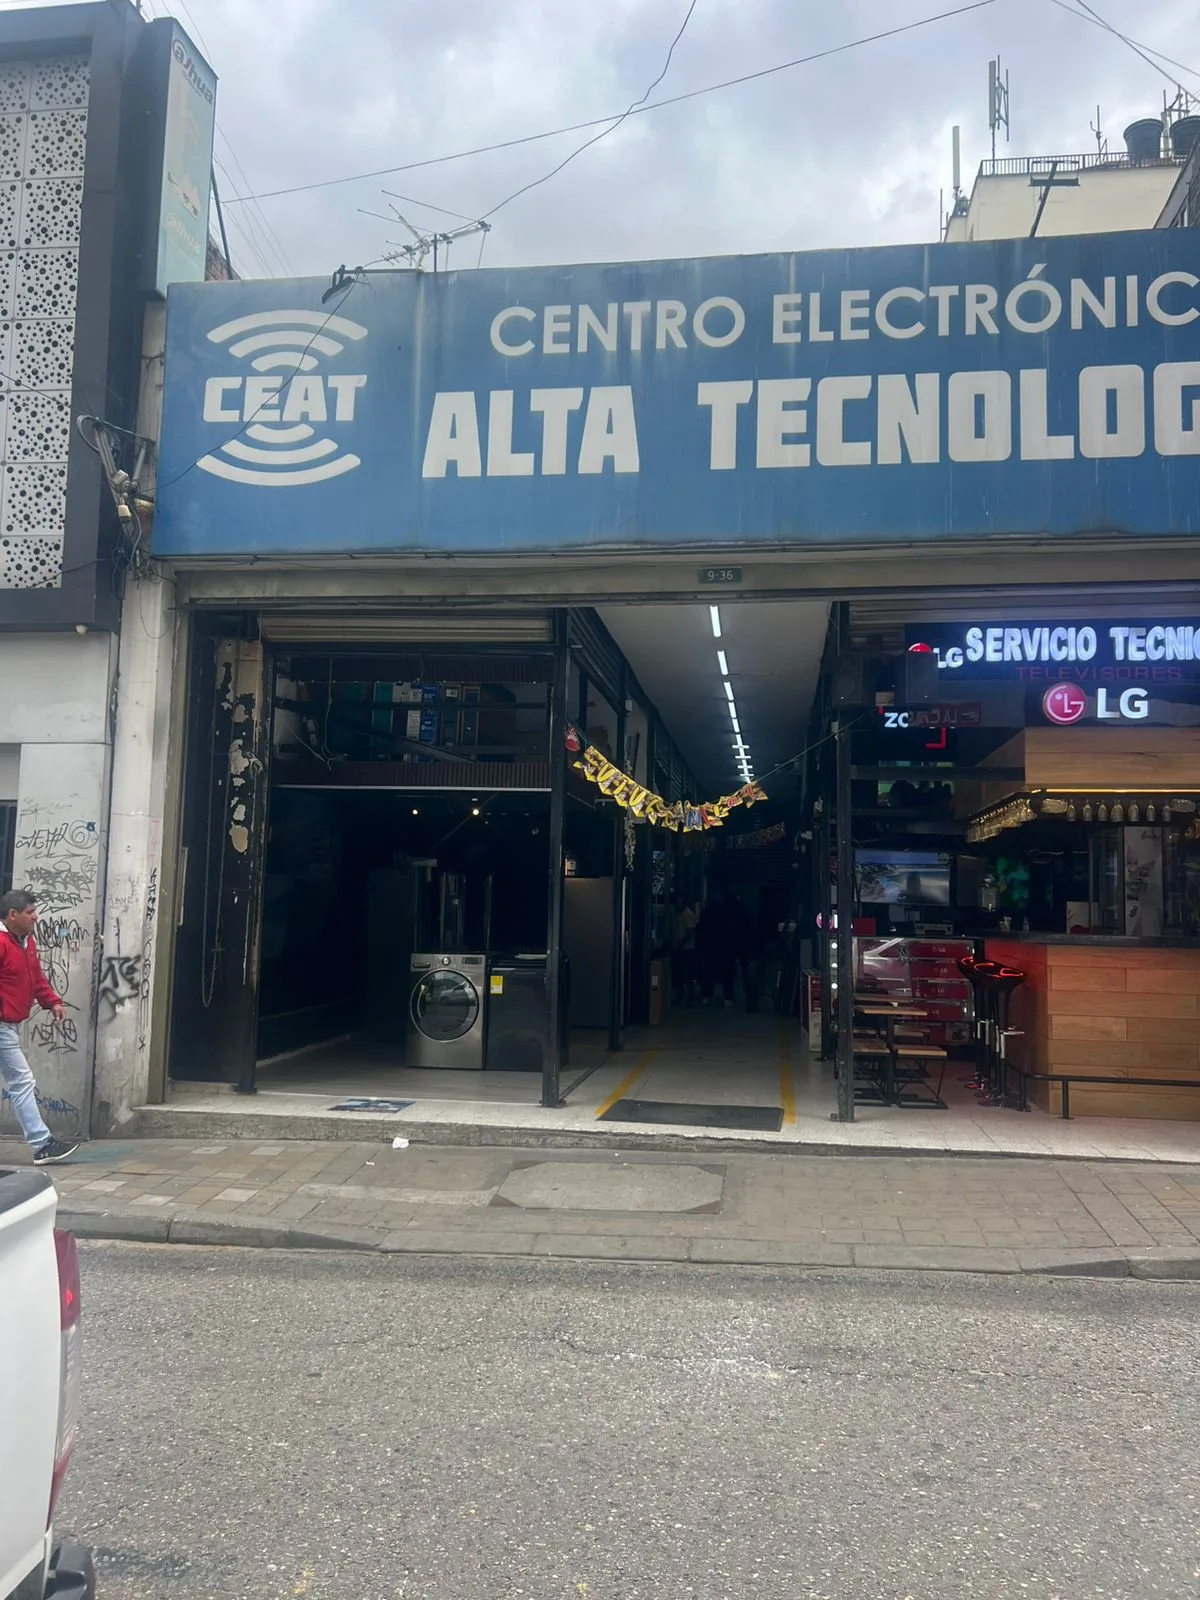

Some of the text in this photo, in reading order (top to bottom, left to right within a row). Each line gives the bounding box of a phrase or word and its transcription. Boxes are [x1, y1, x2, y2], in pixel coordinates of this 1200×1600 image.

[490, 296, 746, 357] CENTRO
[203, 374, 368, 423] CEAT
[421, 385, 640, 479] ALTA
[966, 626, 1098, 662] SERVICIO
[1015, 666, 1182, 681] TELEVISORES
[1096, 687, 1149, 719] LG
